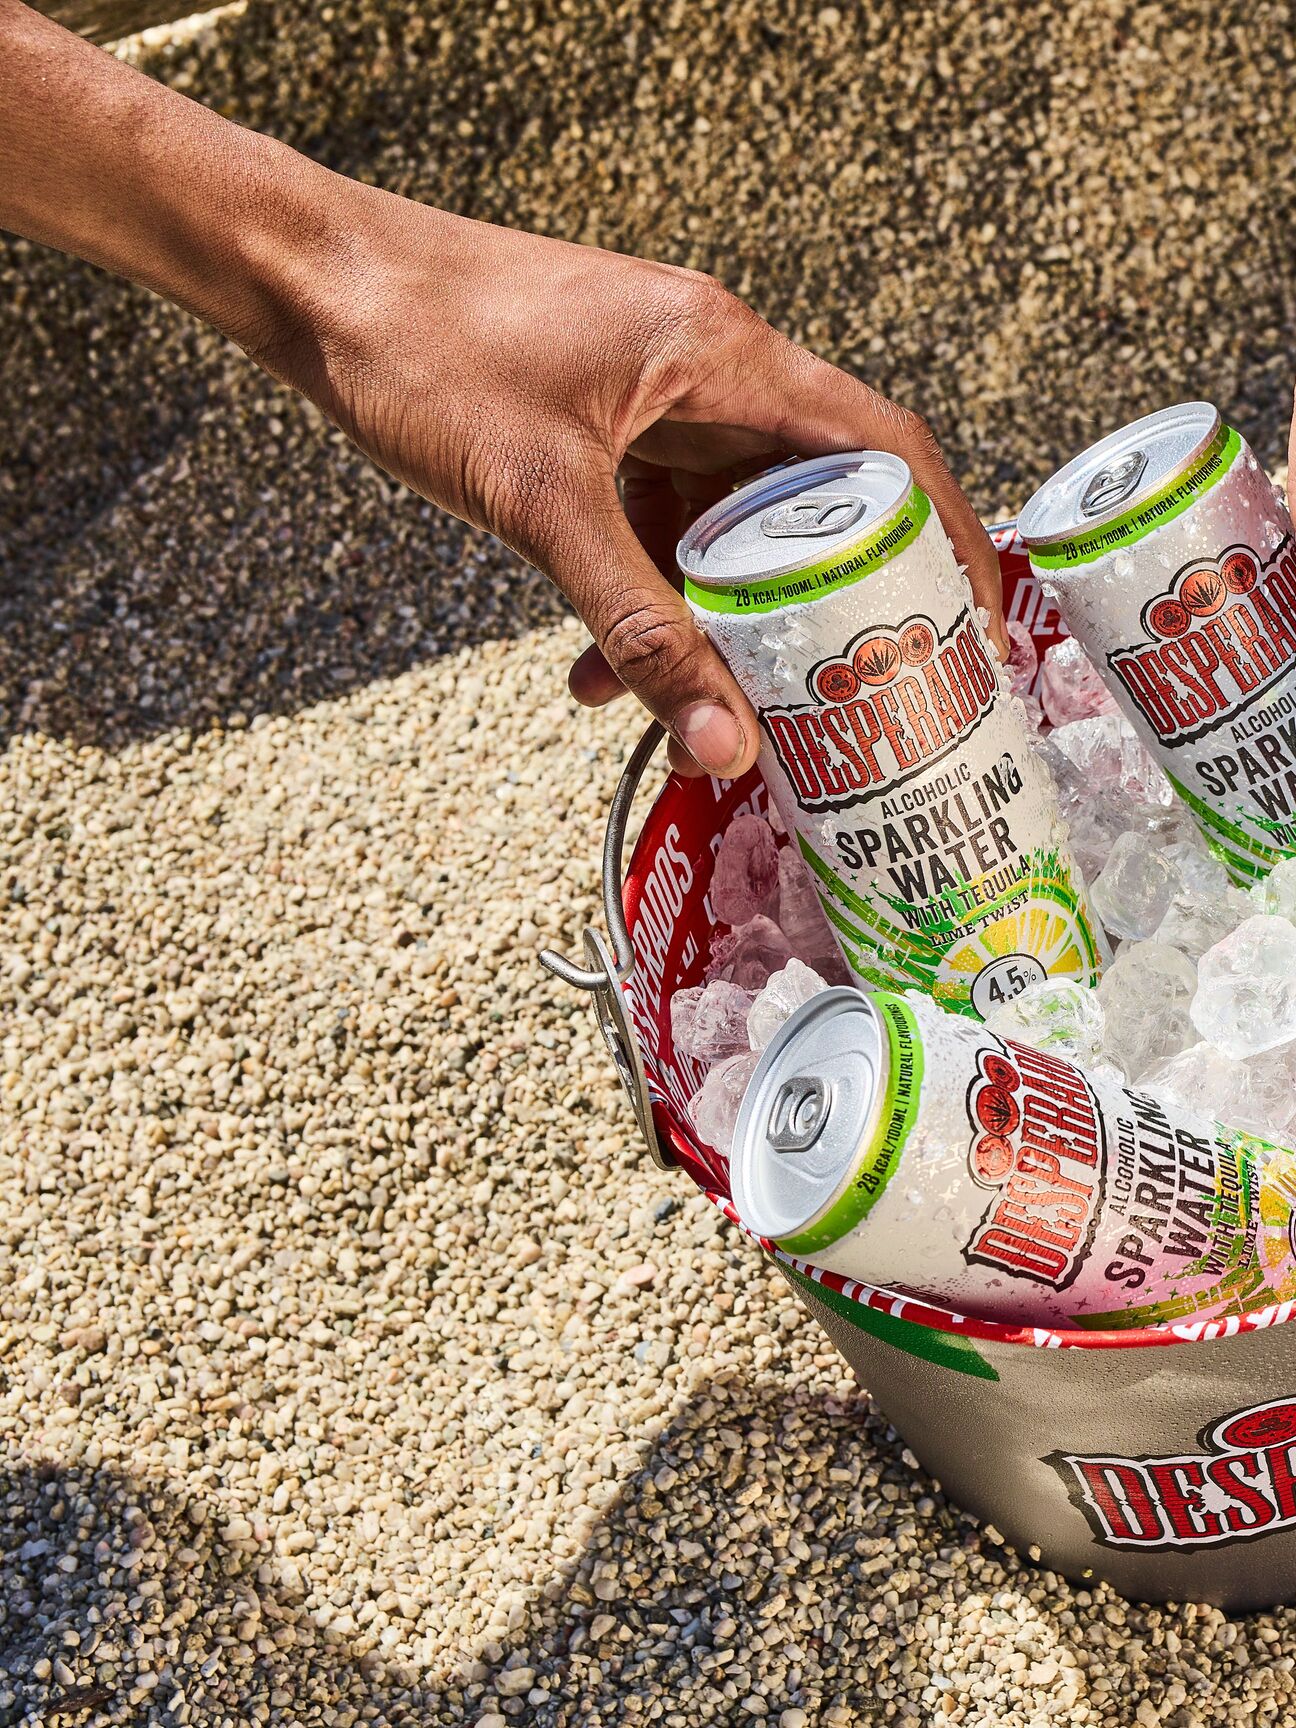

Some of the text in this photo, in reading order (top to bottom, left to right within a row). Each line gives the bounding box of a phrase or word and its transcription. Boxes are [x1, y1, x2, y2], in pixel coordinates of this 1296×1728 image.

[733, 515, 914, 608] 28 KCAL/100ML NATURAL FLAVOURINGS
[1062, 540, 1078, 561] 28
[1079, 522, 1133, 557] KCAL/100ML
[1137, 495, 1179, 526] NATURAL
[1176, 453, 1223, 500] FLAVOURINGS
[767, 618, 996, 800] DESPERADOS
[835, 752, 1024, 870] SPARKLING
[881, 762, 972, 820] ALCOHOLIC
[886, 816, 1019, 904] WATER
[900, 854, 1032, 930] WITH TEQUILA
[930, 889, 1031, 948] LIME TWIST
[989, 964, 1037, 1005] 4.5%
[856, 1001, 914, 1195] 28 KCAL/100ML NATURAL FLAVOURINGS
[973, 1040, 1099, 1280] DESPERADO
[1104, 1087, 1177, 1289] SPARKLING
[1109, 1117, 1135, 1216] ALCOHOLIC
[1162, 1128, 1217, 1259] WATER
[1202, 1140, 1240, 1276] WITH TEQUILA
[1237, 1159, 1262, 1271] LIME TWIST
